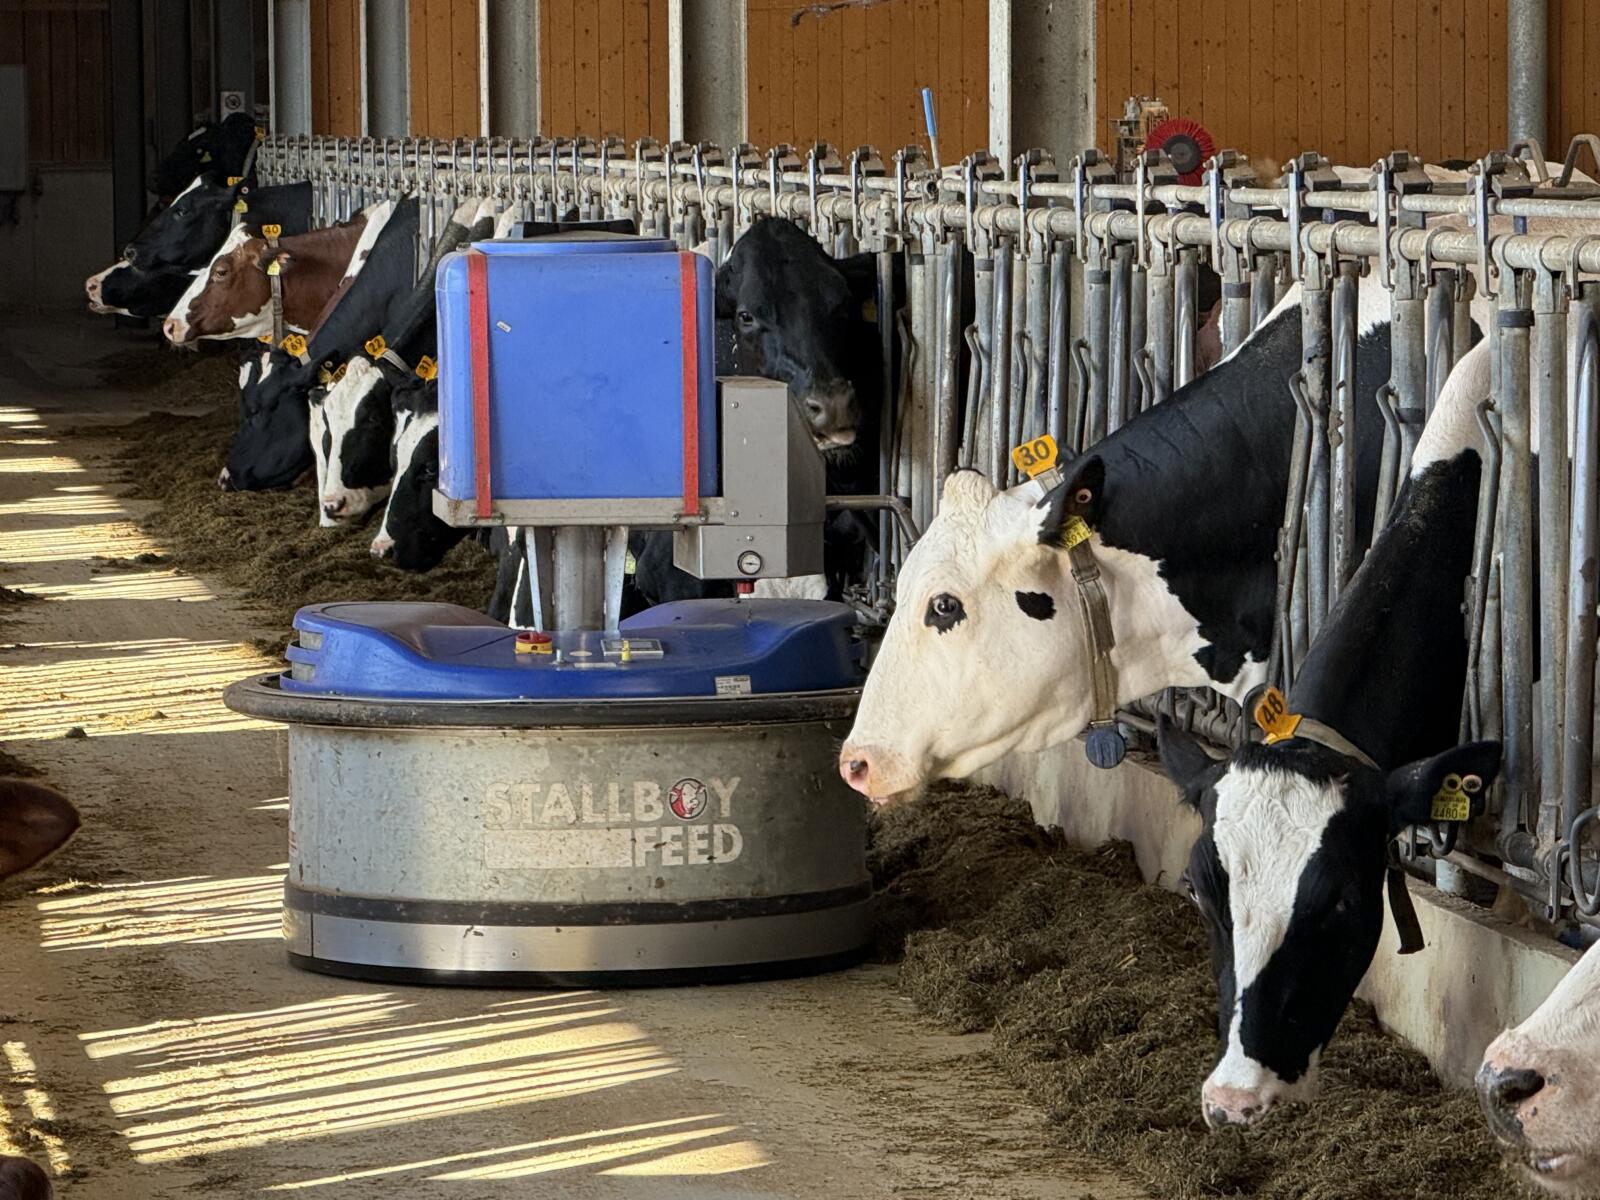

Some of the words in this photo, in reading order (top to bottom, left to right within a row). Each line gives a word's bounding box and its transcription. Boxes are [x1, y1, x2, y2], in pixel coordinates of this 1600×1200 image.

[264, 226, 278, 234] 40
[369, 339, 382, 353] 22
[419, 360, 431, 374] 31
[1019, 440, 1050, 466] 30
[1262, 692, 1283, 724] 48
[634, 824, 743, 867] FEED
